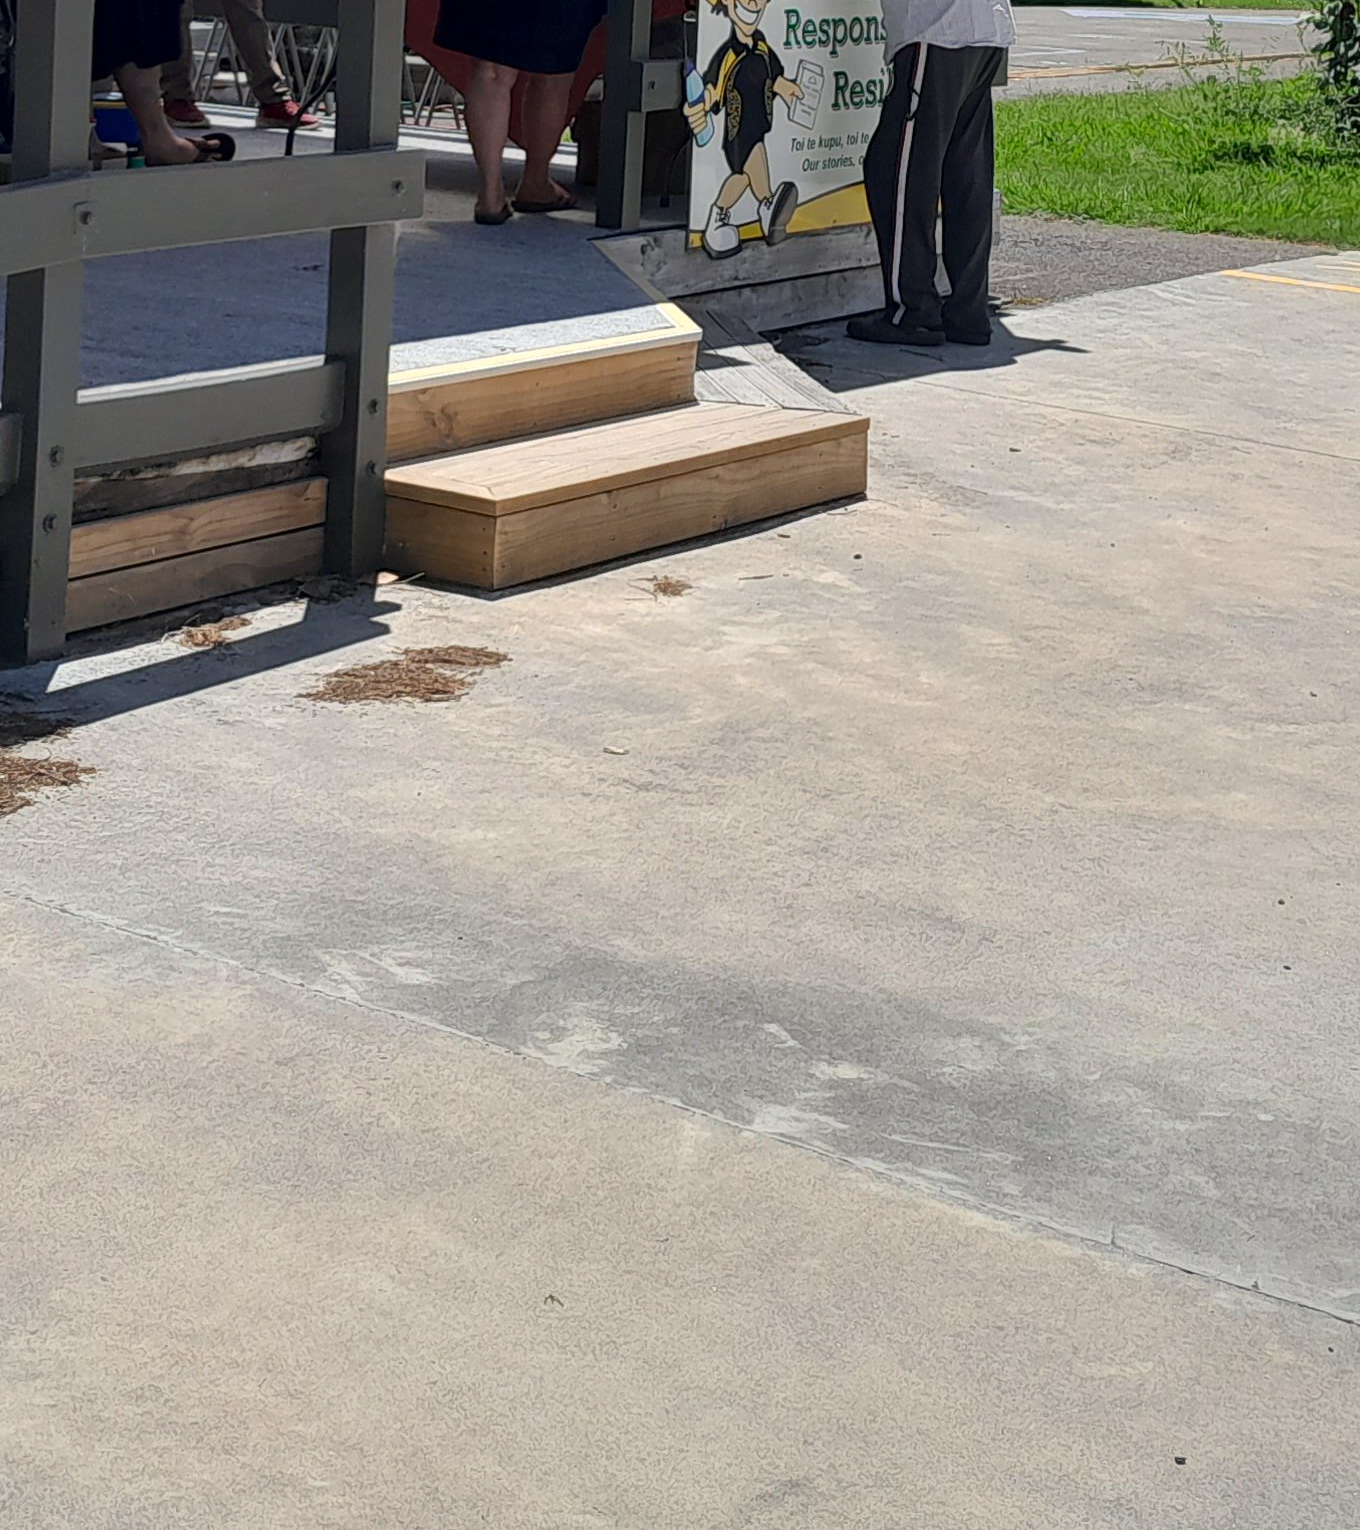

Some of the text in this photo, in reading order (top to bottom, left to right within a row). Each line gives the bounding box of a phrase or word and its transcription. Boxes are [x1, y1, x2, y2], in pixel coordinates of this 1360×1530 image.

[831, 64, 891, 111] Resi
[791, 132, 870, 152] Toi te kupu, toi te
[802, 158, 820, 172] Our
[822, 154, 856, 170] stories,
